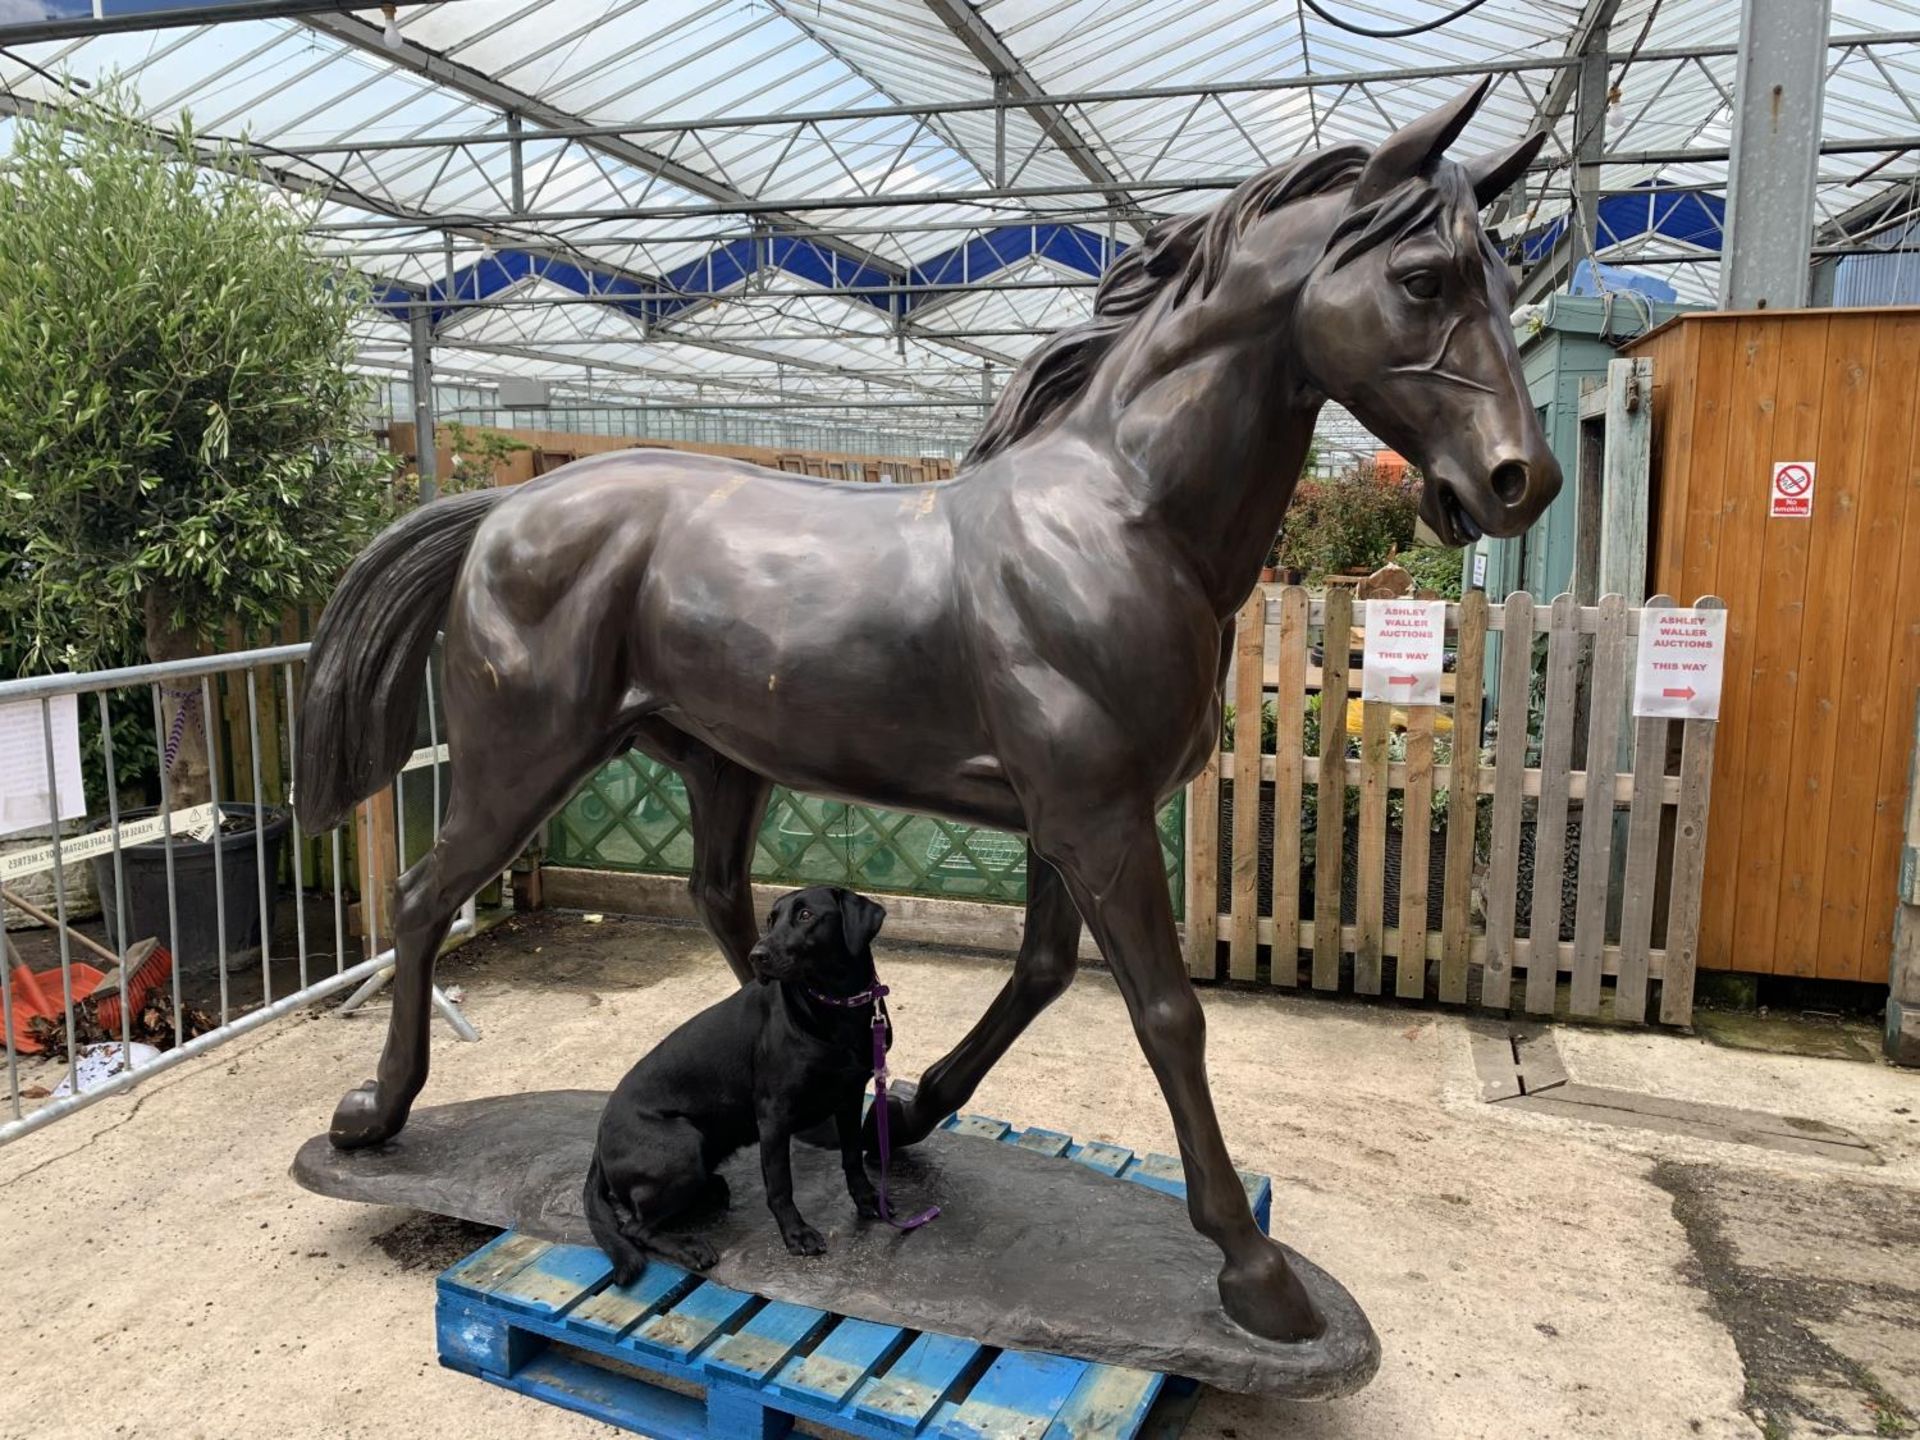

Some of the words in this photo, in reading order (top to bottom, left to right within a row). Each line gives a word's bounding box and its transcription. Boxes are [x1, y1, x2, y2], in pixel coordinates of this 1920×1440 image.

[1774, 506, 1807, 514] smoking
[1384, 608, 1426, 616] ASHLEY
[1385, 619, 1428, 627] WALLER
[1659, 617, 1706, 625] ASHLEY
[1379, 630, 1433, 638] AUCTIONS
[1660, 628, 1707, 636] WALLER
[1653, 640, 1713, 648] AUCTIONS
[1378, 652, 1403, 660] THIS
[1406, 652, 1429, 660] WAY
[1652, 662, 1678, 670] THIS
[1682, 663, 1708, 671] WAY
